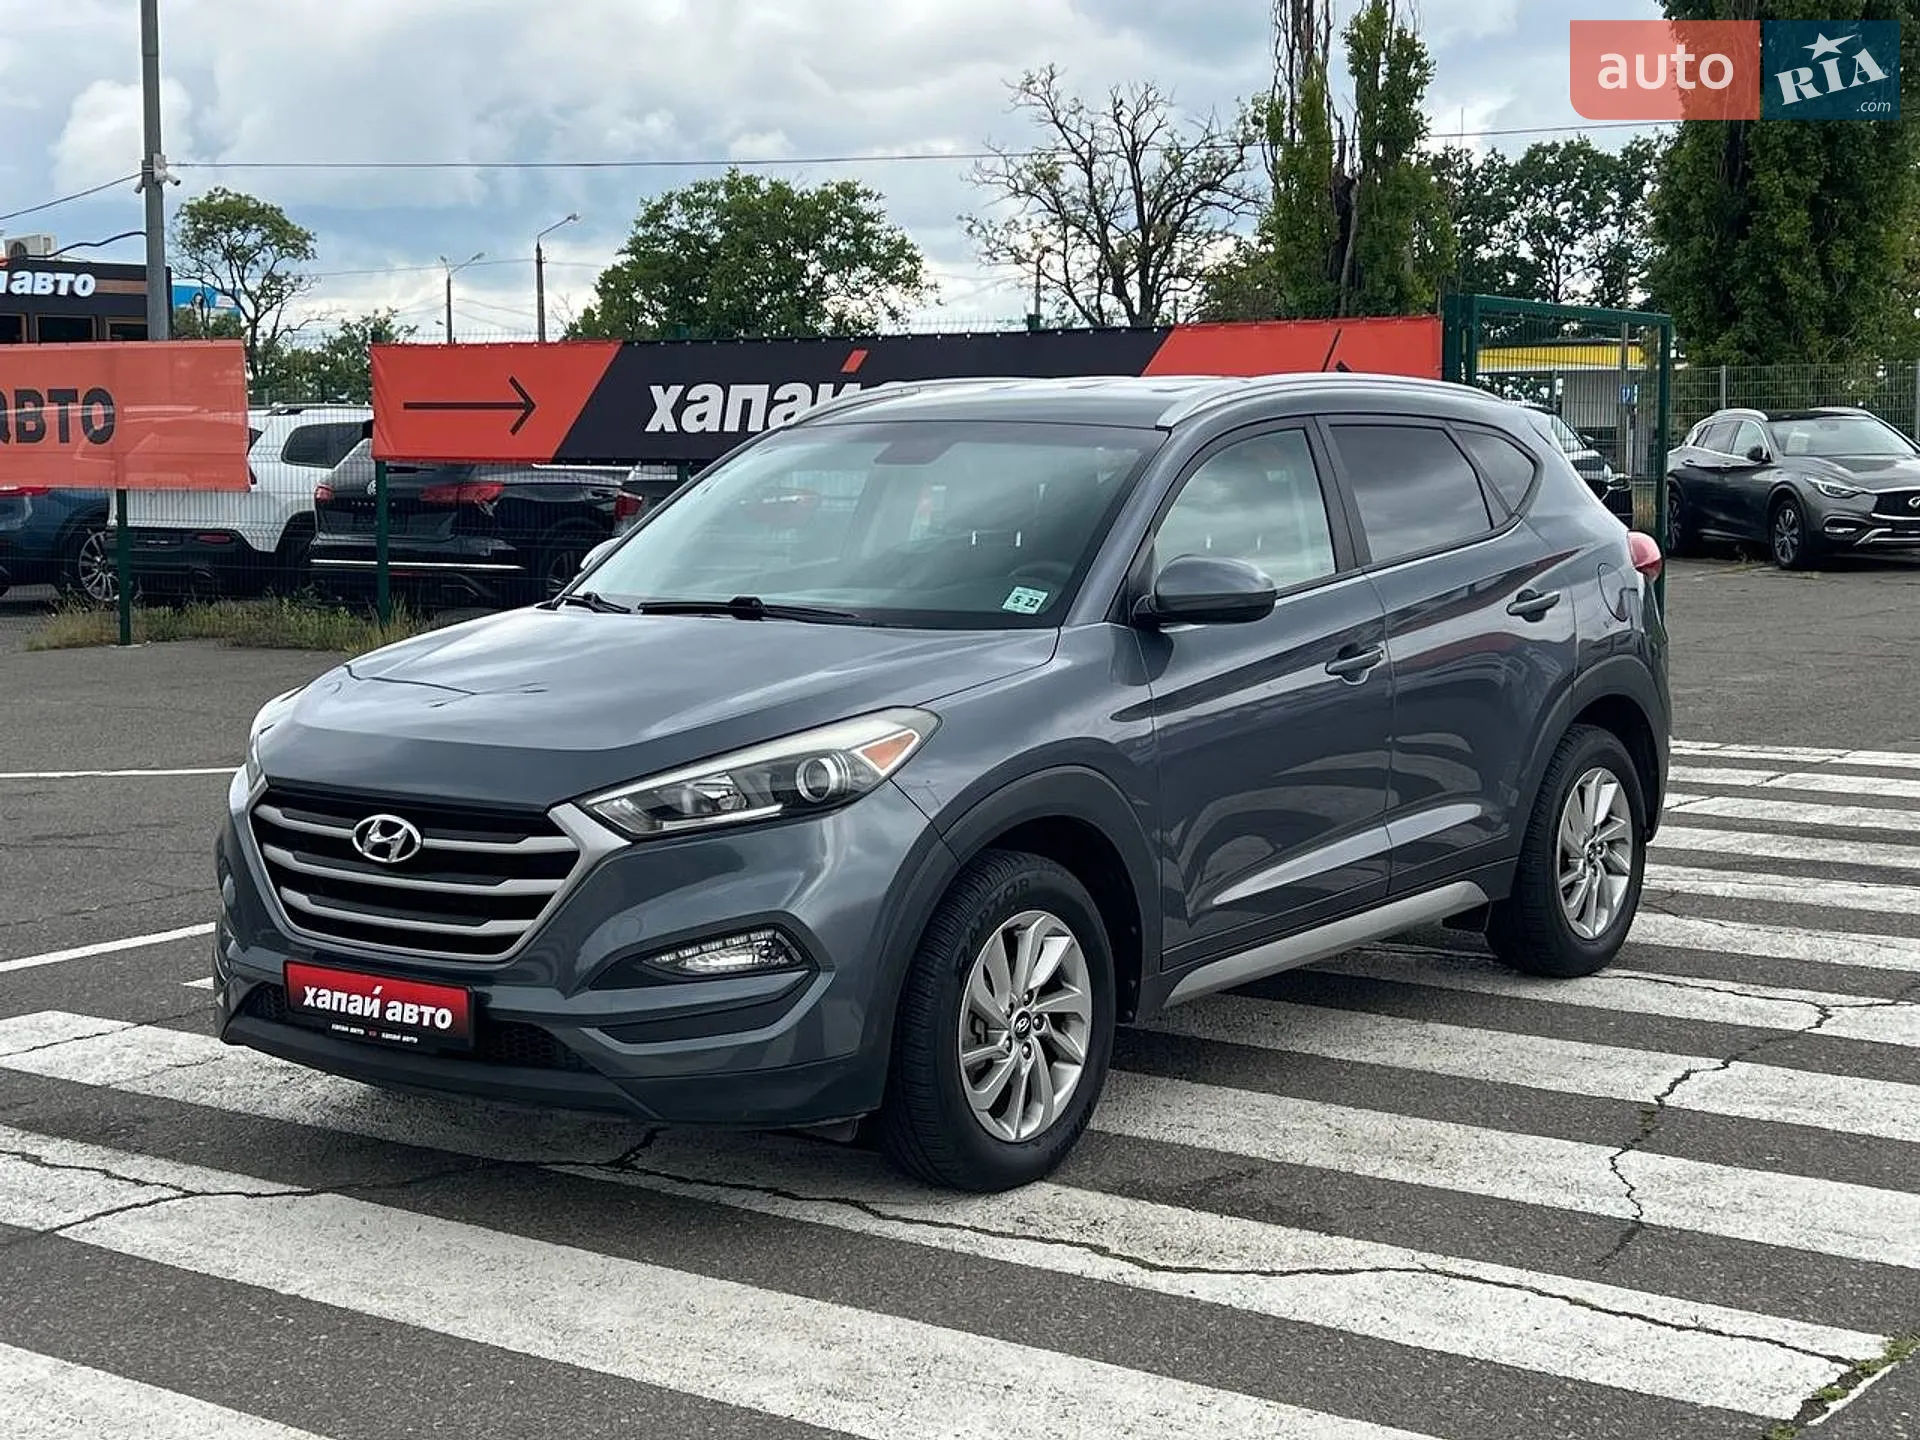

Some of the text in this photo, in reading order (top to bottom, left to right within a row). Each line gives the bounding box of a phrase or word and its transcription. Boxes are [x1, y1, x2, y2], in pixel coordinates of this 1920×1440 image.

[10, 271, 96, 297] авто
[302, 985, 453, 1029] хапай авто
